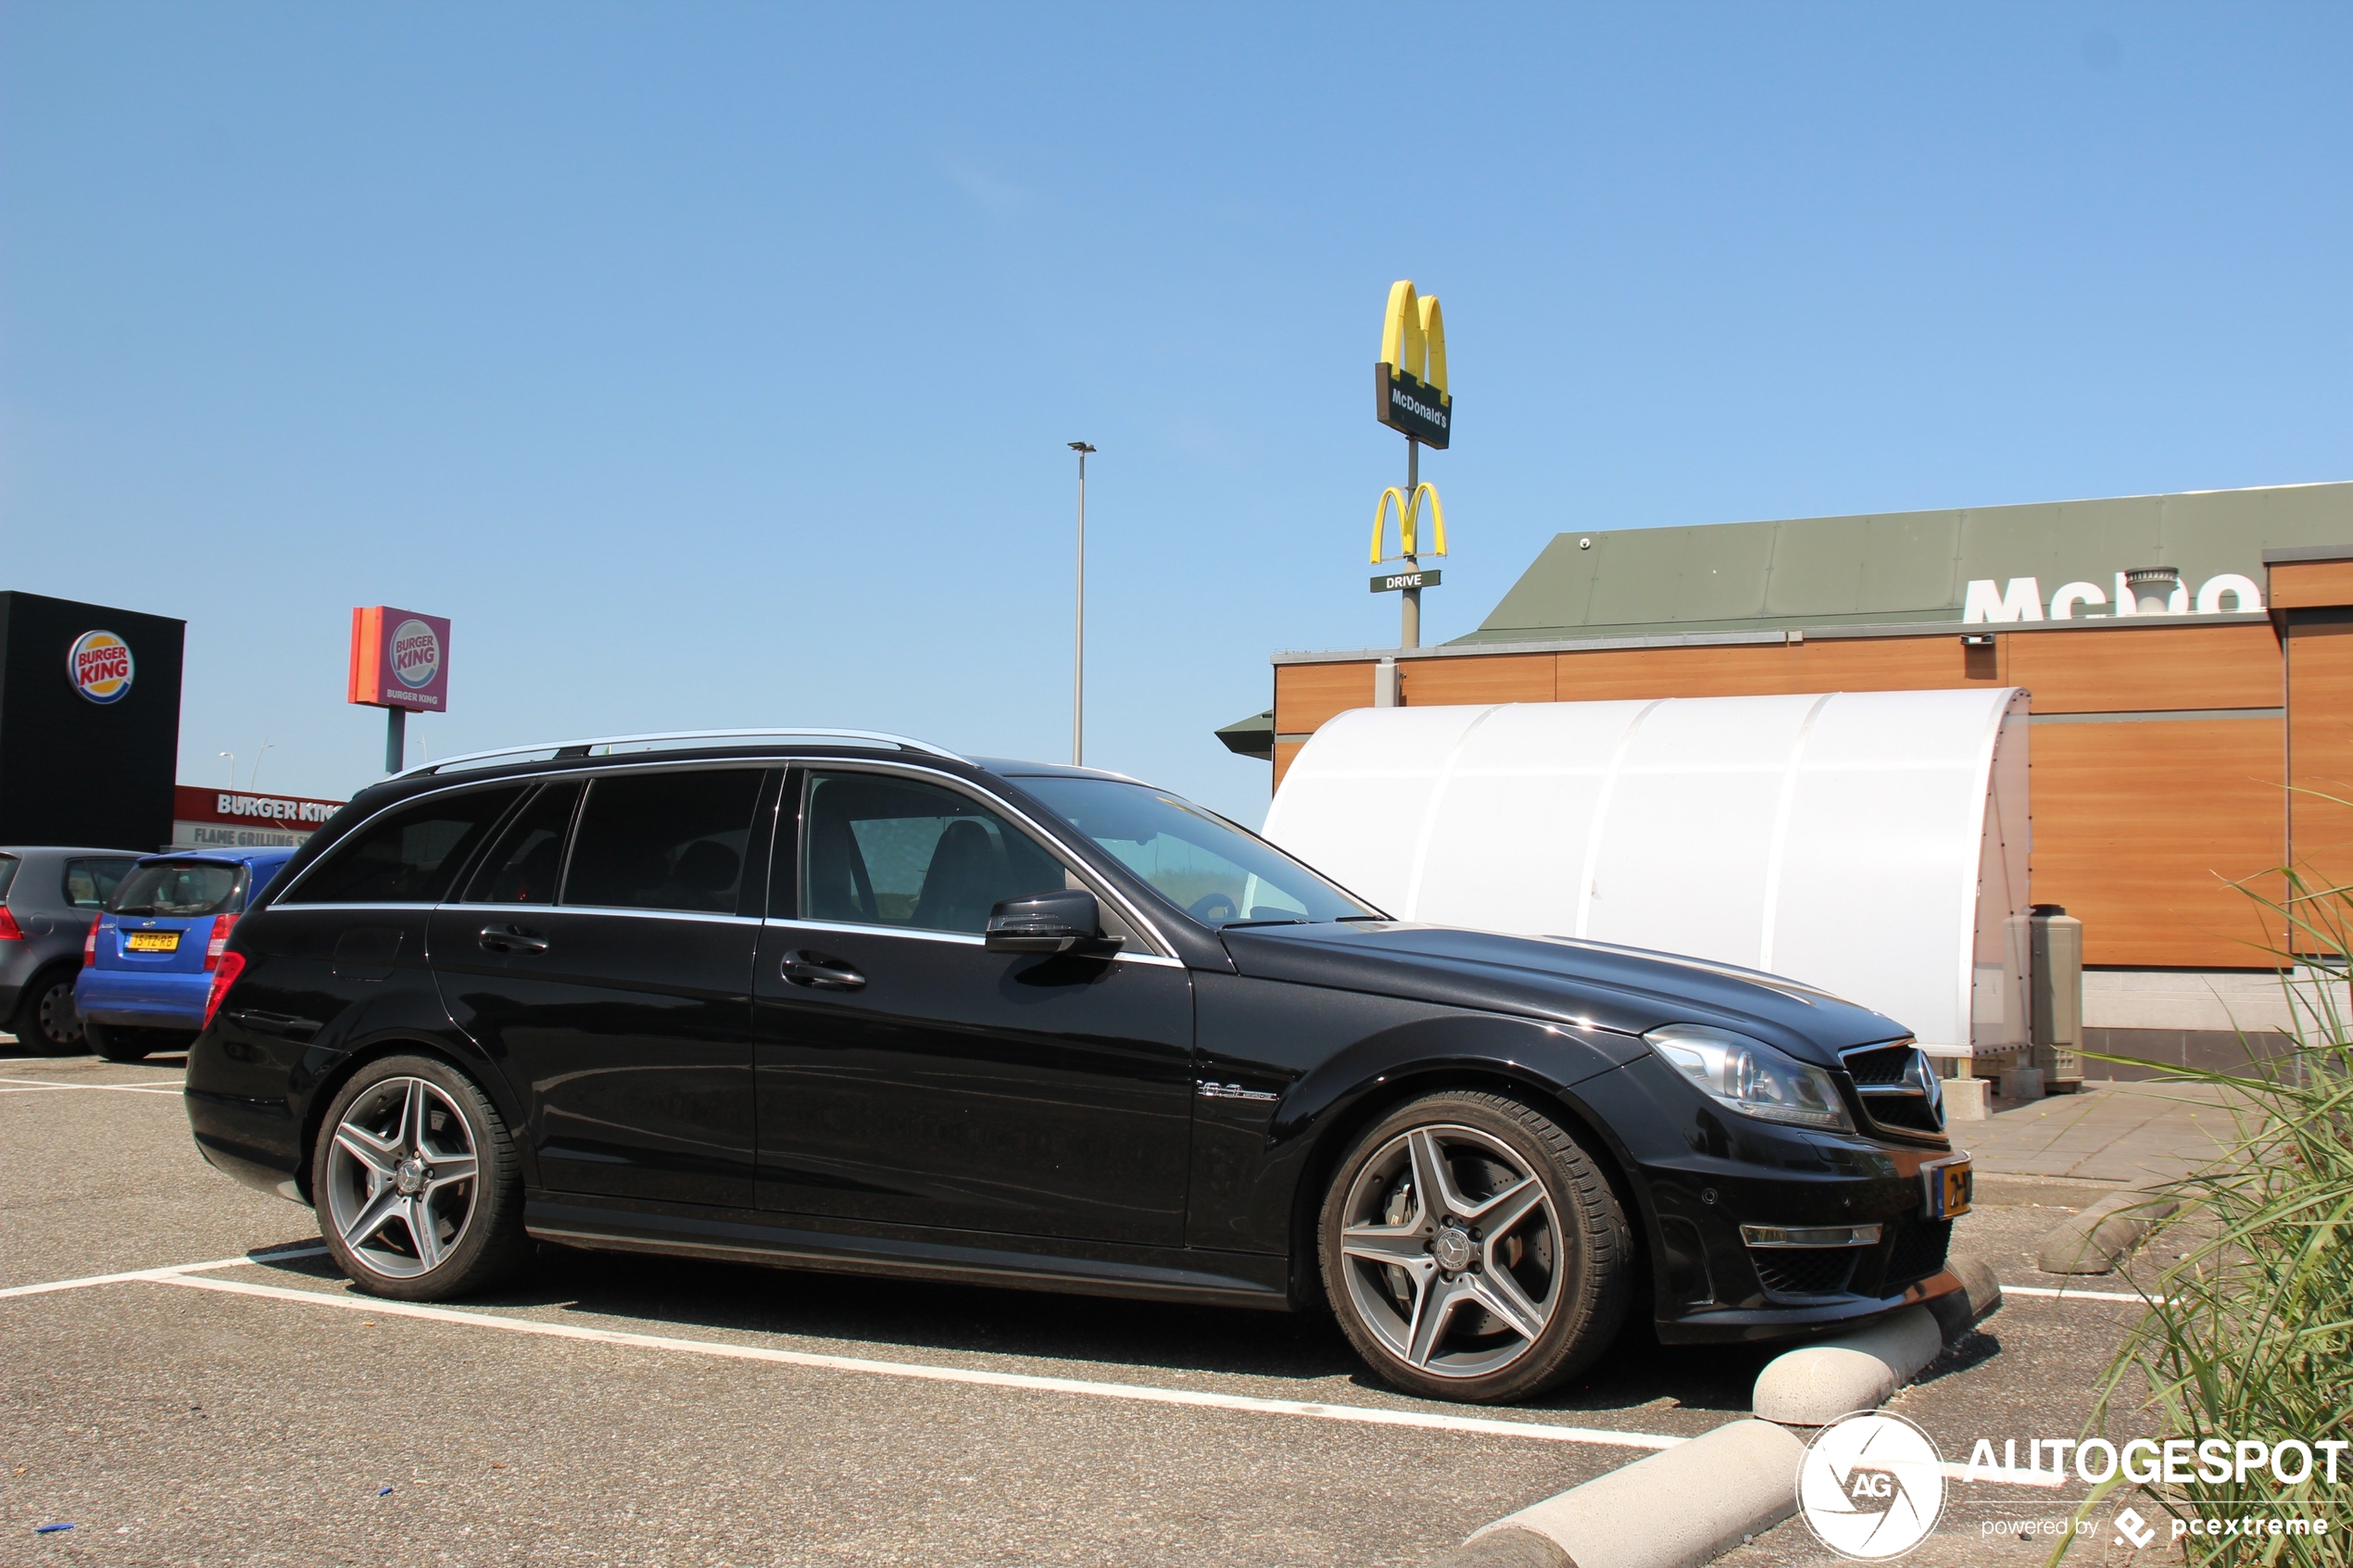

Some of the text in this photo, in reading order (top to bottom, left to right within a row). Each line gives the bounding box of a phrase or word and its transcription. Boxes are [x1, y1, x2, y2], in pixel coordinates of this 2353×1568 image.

[1392, 388, 1447, 429] McDonald's
[1386, 573, 1422, 589] DRIVE
[396, 635, 434, 654] BURGER
[78, 646, 127, 667] BURGER
[396, 646, 434, 671] KING
[79, 659, 128, 685] KING
[386, 689, 437, 705] BURGER KING
[217, 794, 297, 821] BURGER
[195, 828, 235, 846] FLAME
[238, 831, 294, 847] GRILLING
